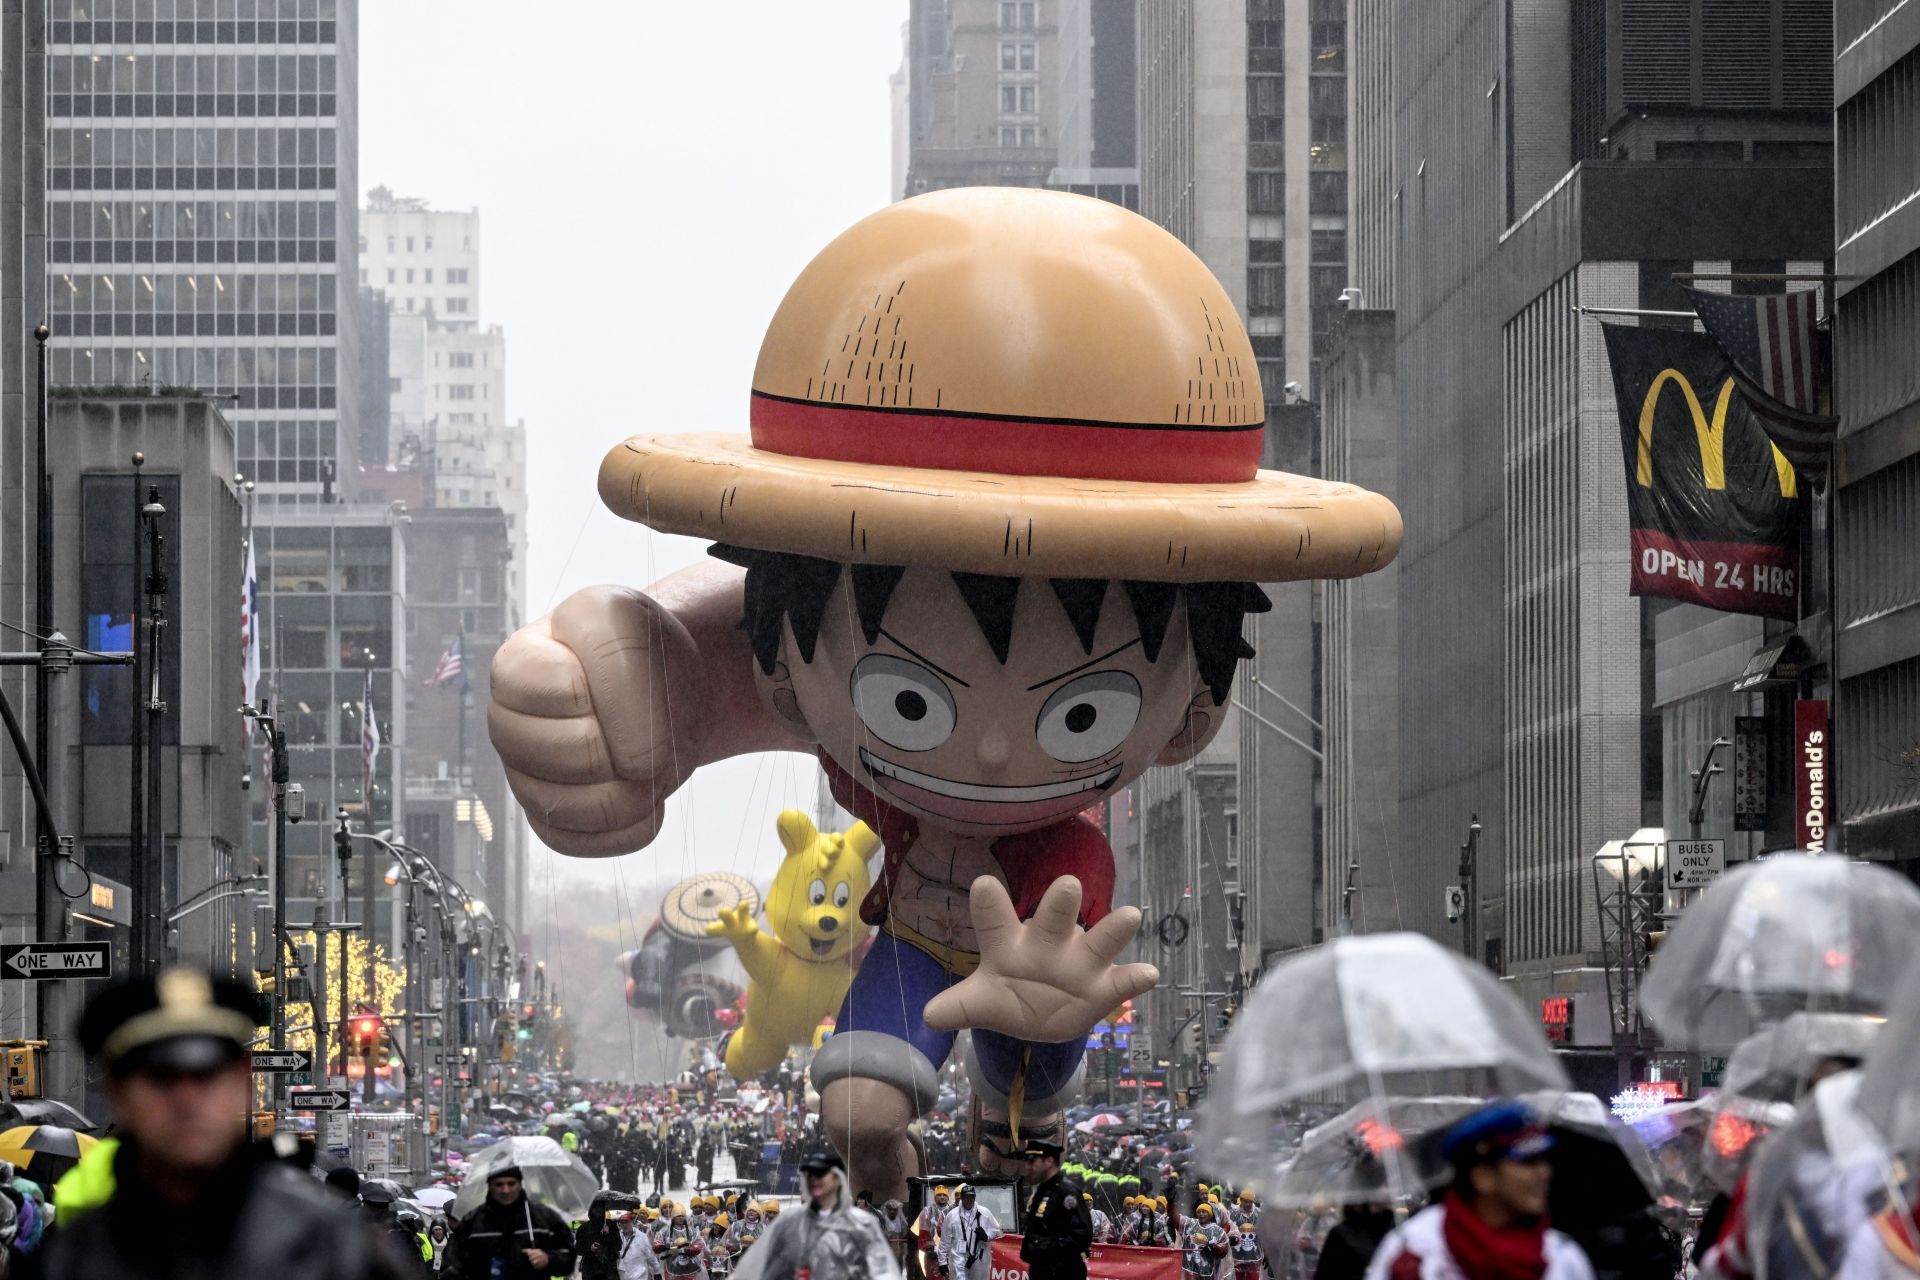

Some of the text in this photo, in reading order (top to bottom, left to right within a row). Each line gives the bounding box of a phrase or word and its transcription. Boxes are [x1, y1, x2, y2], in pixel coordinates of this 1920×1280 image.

[1641, 547, 1795, 597] OPEN 24 HRS
[1805, 730, 1825, 857] McDonald's
[1678, 844, 1714, 855] BUSES
[1682, 857, 1711, 867] ONLY
[17, 953, 96, 969] ONE WAY
[254, 1056, 302, 1066] ONE WAY
[1132, 1049, 1150, 1061] 25
[292, 1073, 304, 1086] 46
[297, 1096, 339, 1105] ONE WAY
